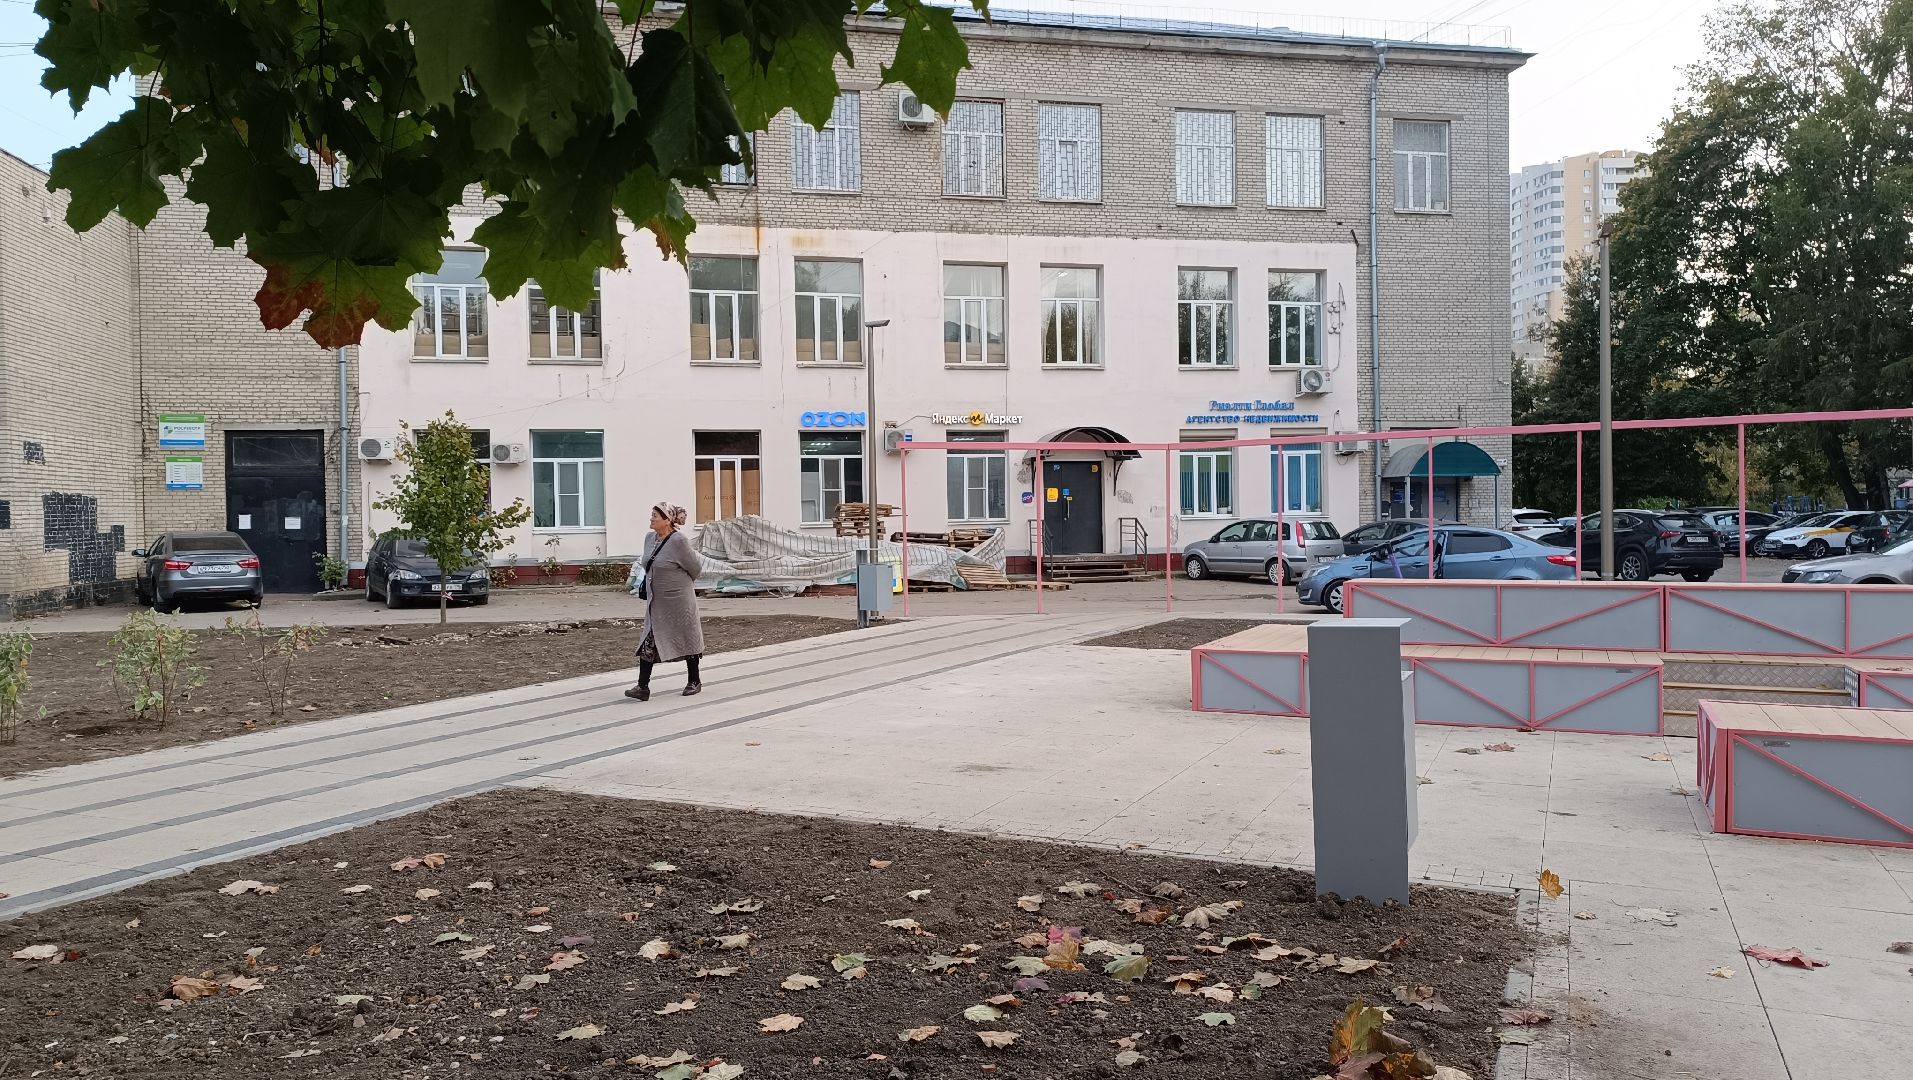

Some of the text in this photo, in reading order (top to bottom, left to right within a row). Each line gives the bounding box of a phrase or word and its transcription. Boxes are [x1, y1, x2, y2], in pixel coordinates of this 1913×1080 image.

[800, 411, 866, 427] OZON
[932, 413, 968, 425] Яндекс
[984, 413, 1023, 426] Маркет
